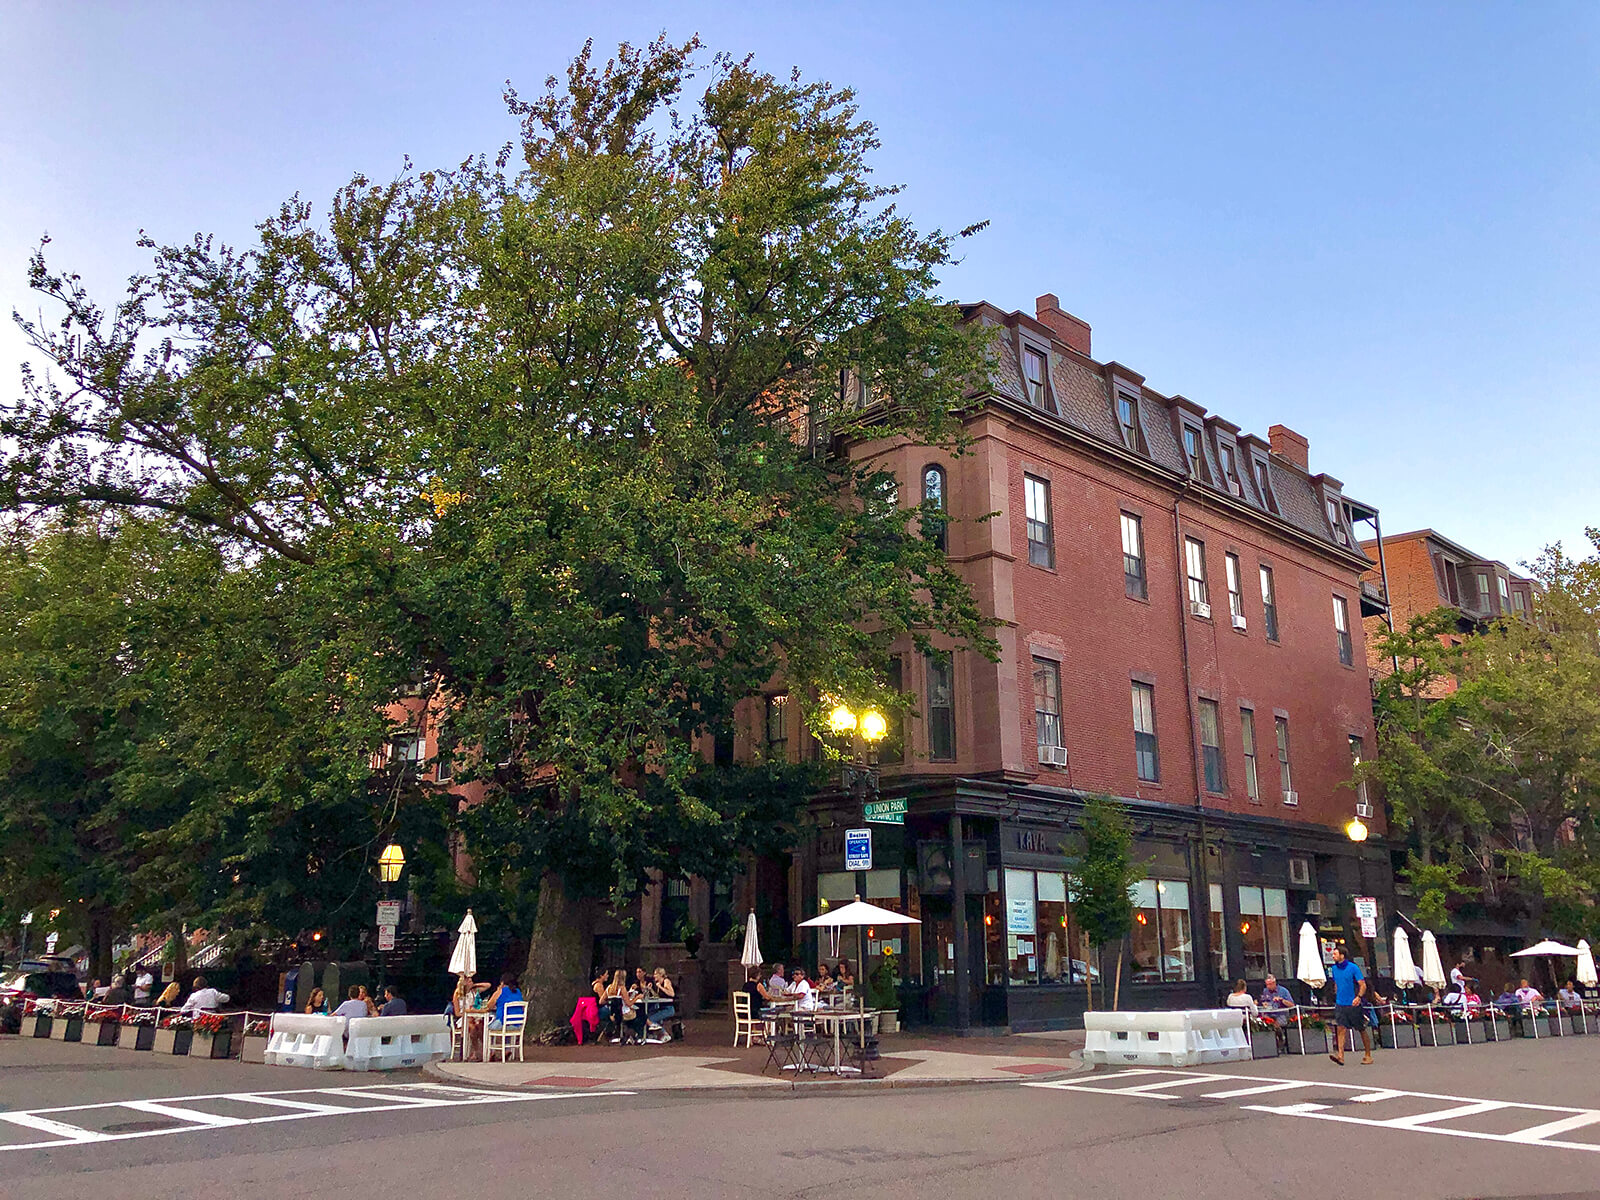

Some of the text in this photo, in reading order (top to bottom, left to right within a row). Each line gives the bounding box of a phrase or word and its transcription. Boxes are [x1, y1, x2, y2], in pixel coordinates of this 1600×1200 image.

[873, 800, 905, 814] UNION PARK
[1017, 830, 1047, 852] KAVA
